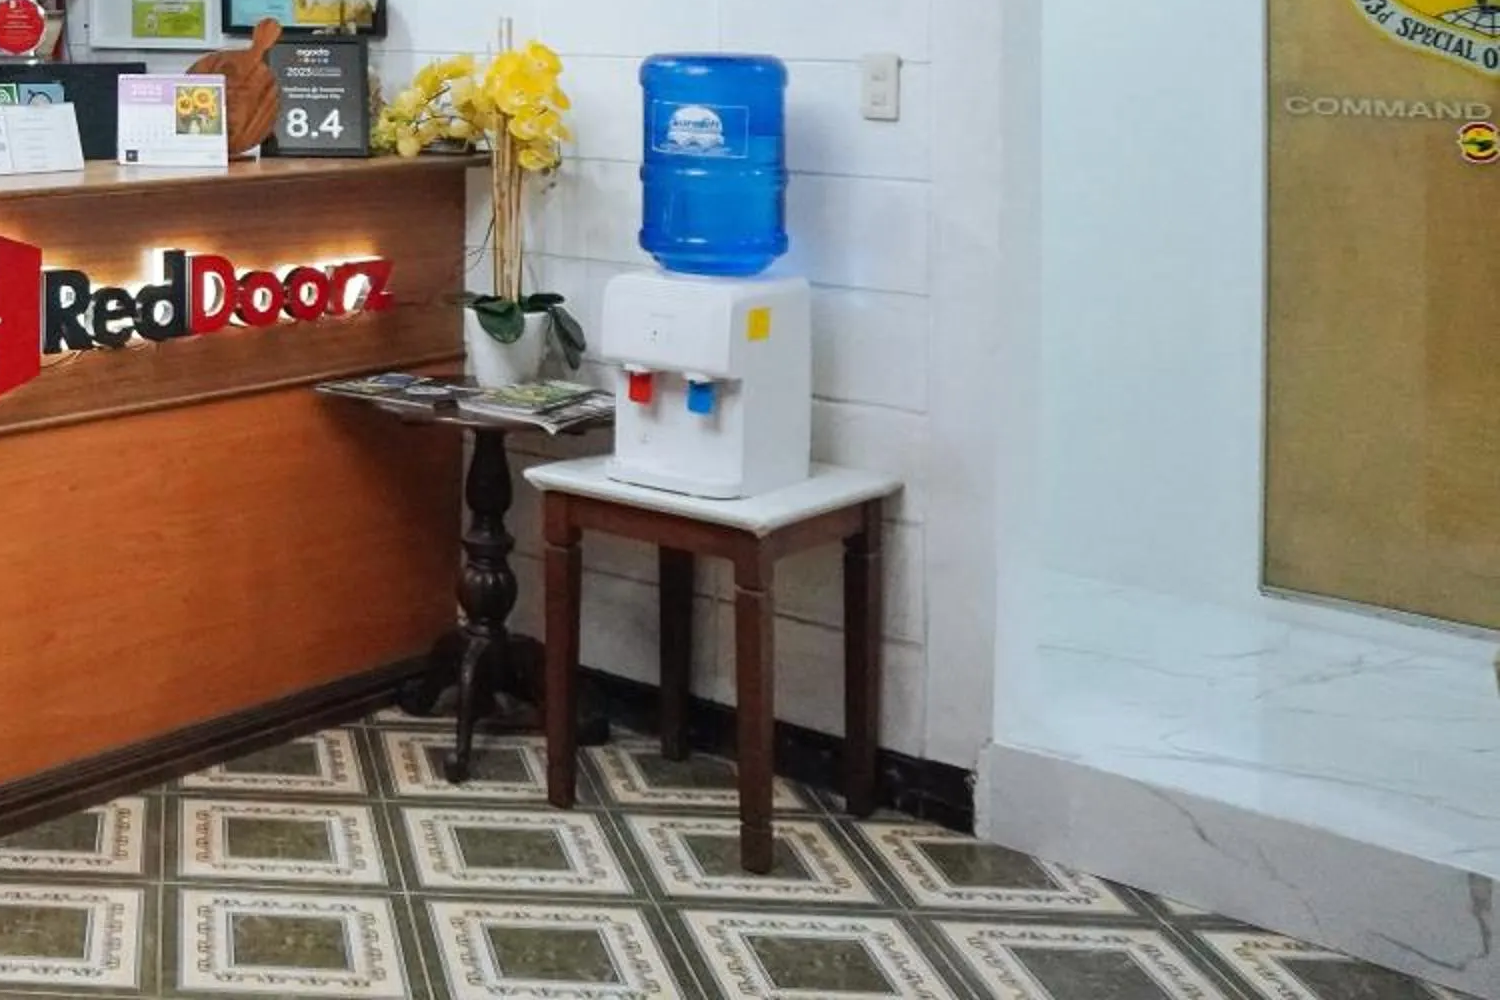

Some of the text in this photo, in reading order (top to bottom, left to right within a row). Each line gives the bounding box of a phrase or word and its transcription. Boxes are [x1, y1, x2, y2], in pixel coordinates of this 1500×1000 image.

[1395, 16, 1478, 61] SPECIAL
[1483, 45, 1500, 70] O
[286, 108, 344, 139] 8.4
[1285, 96, 1493, 120] COMMAND
[42, 248, 395, 355] RedDoorz
